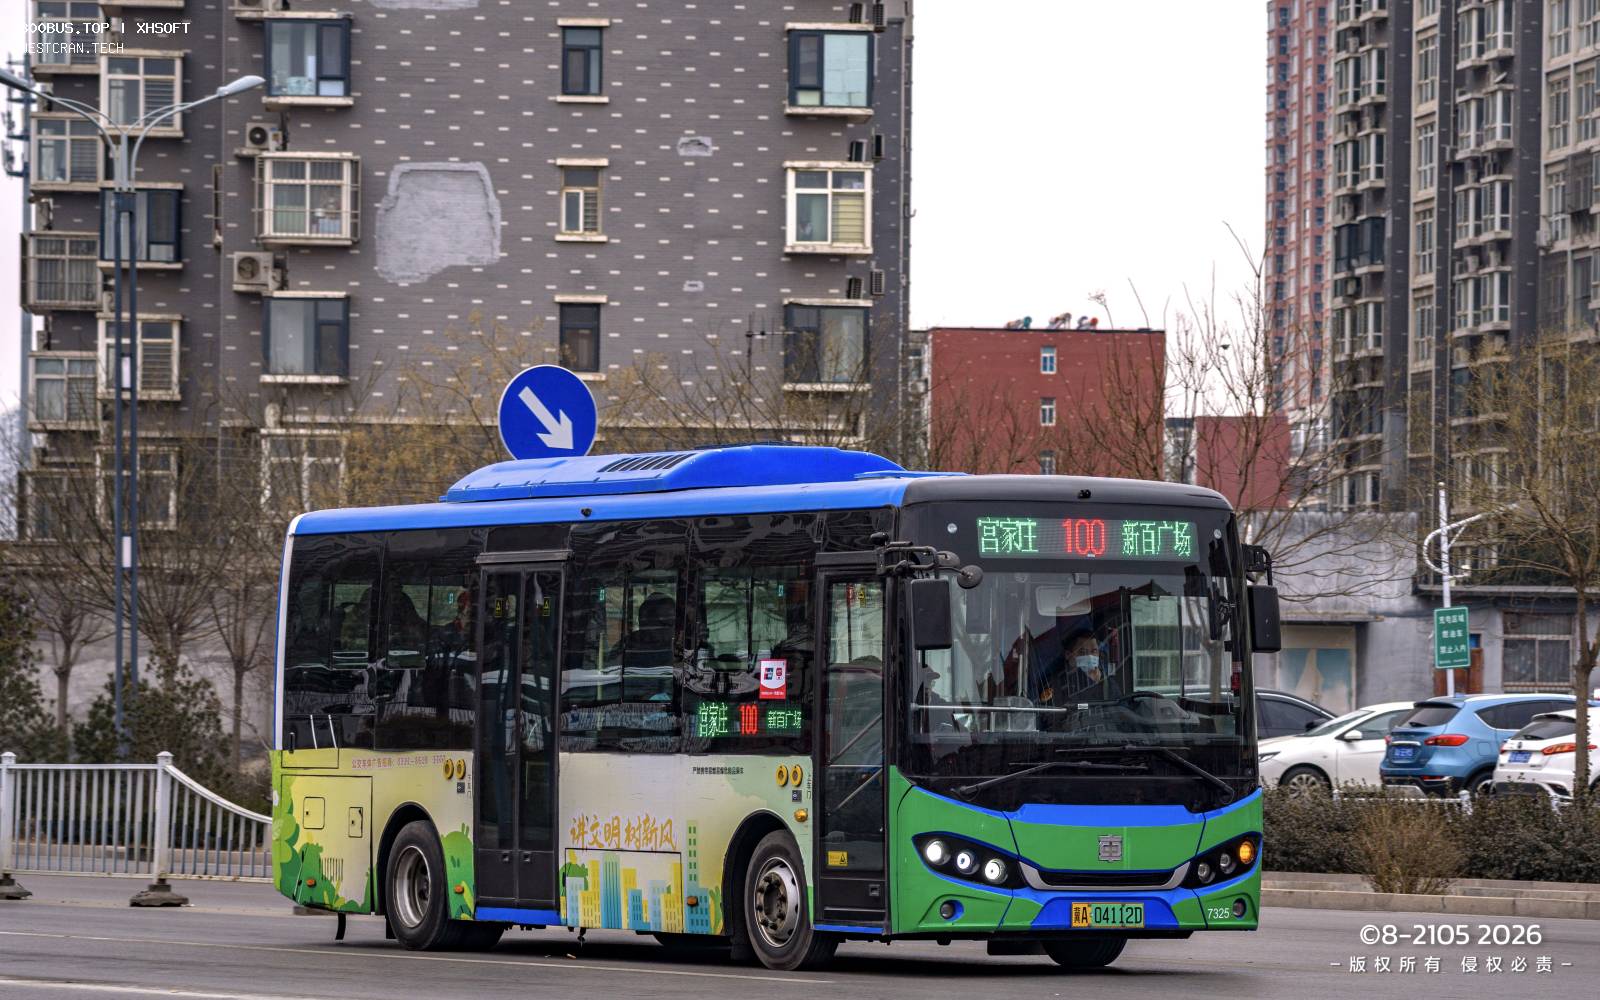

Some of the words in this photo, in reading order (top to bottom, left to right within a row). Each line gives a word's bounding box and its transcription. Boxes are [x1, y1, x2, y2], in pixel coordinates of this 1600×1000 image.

[1062, 518, 1106, 556] 100
[1121, 520, 1192, 557] 新百广场
[738, 702, 758, 737] 100
[766, 709, 803, 730] 新百广场
[569, 812, 678, 852] 讲文明树新风
[1207, 907, 1230, 920] 7325
